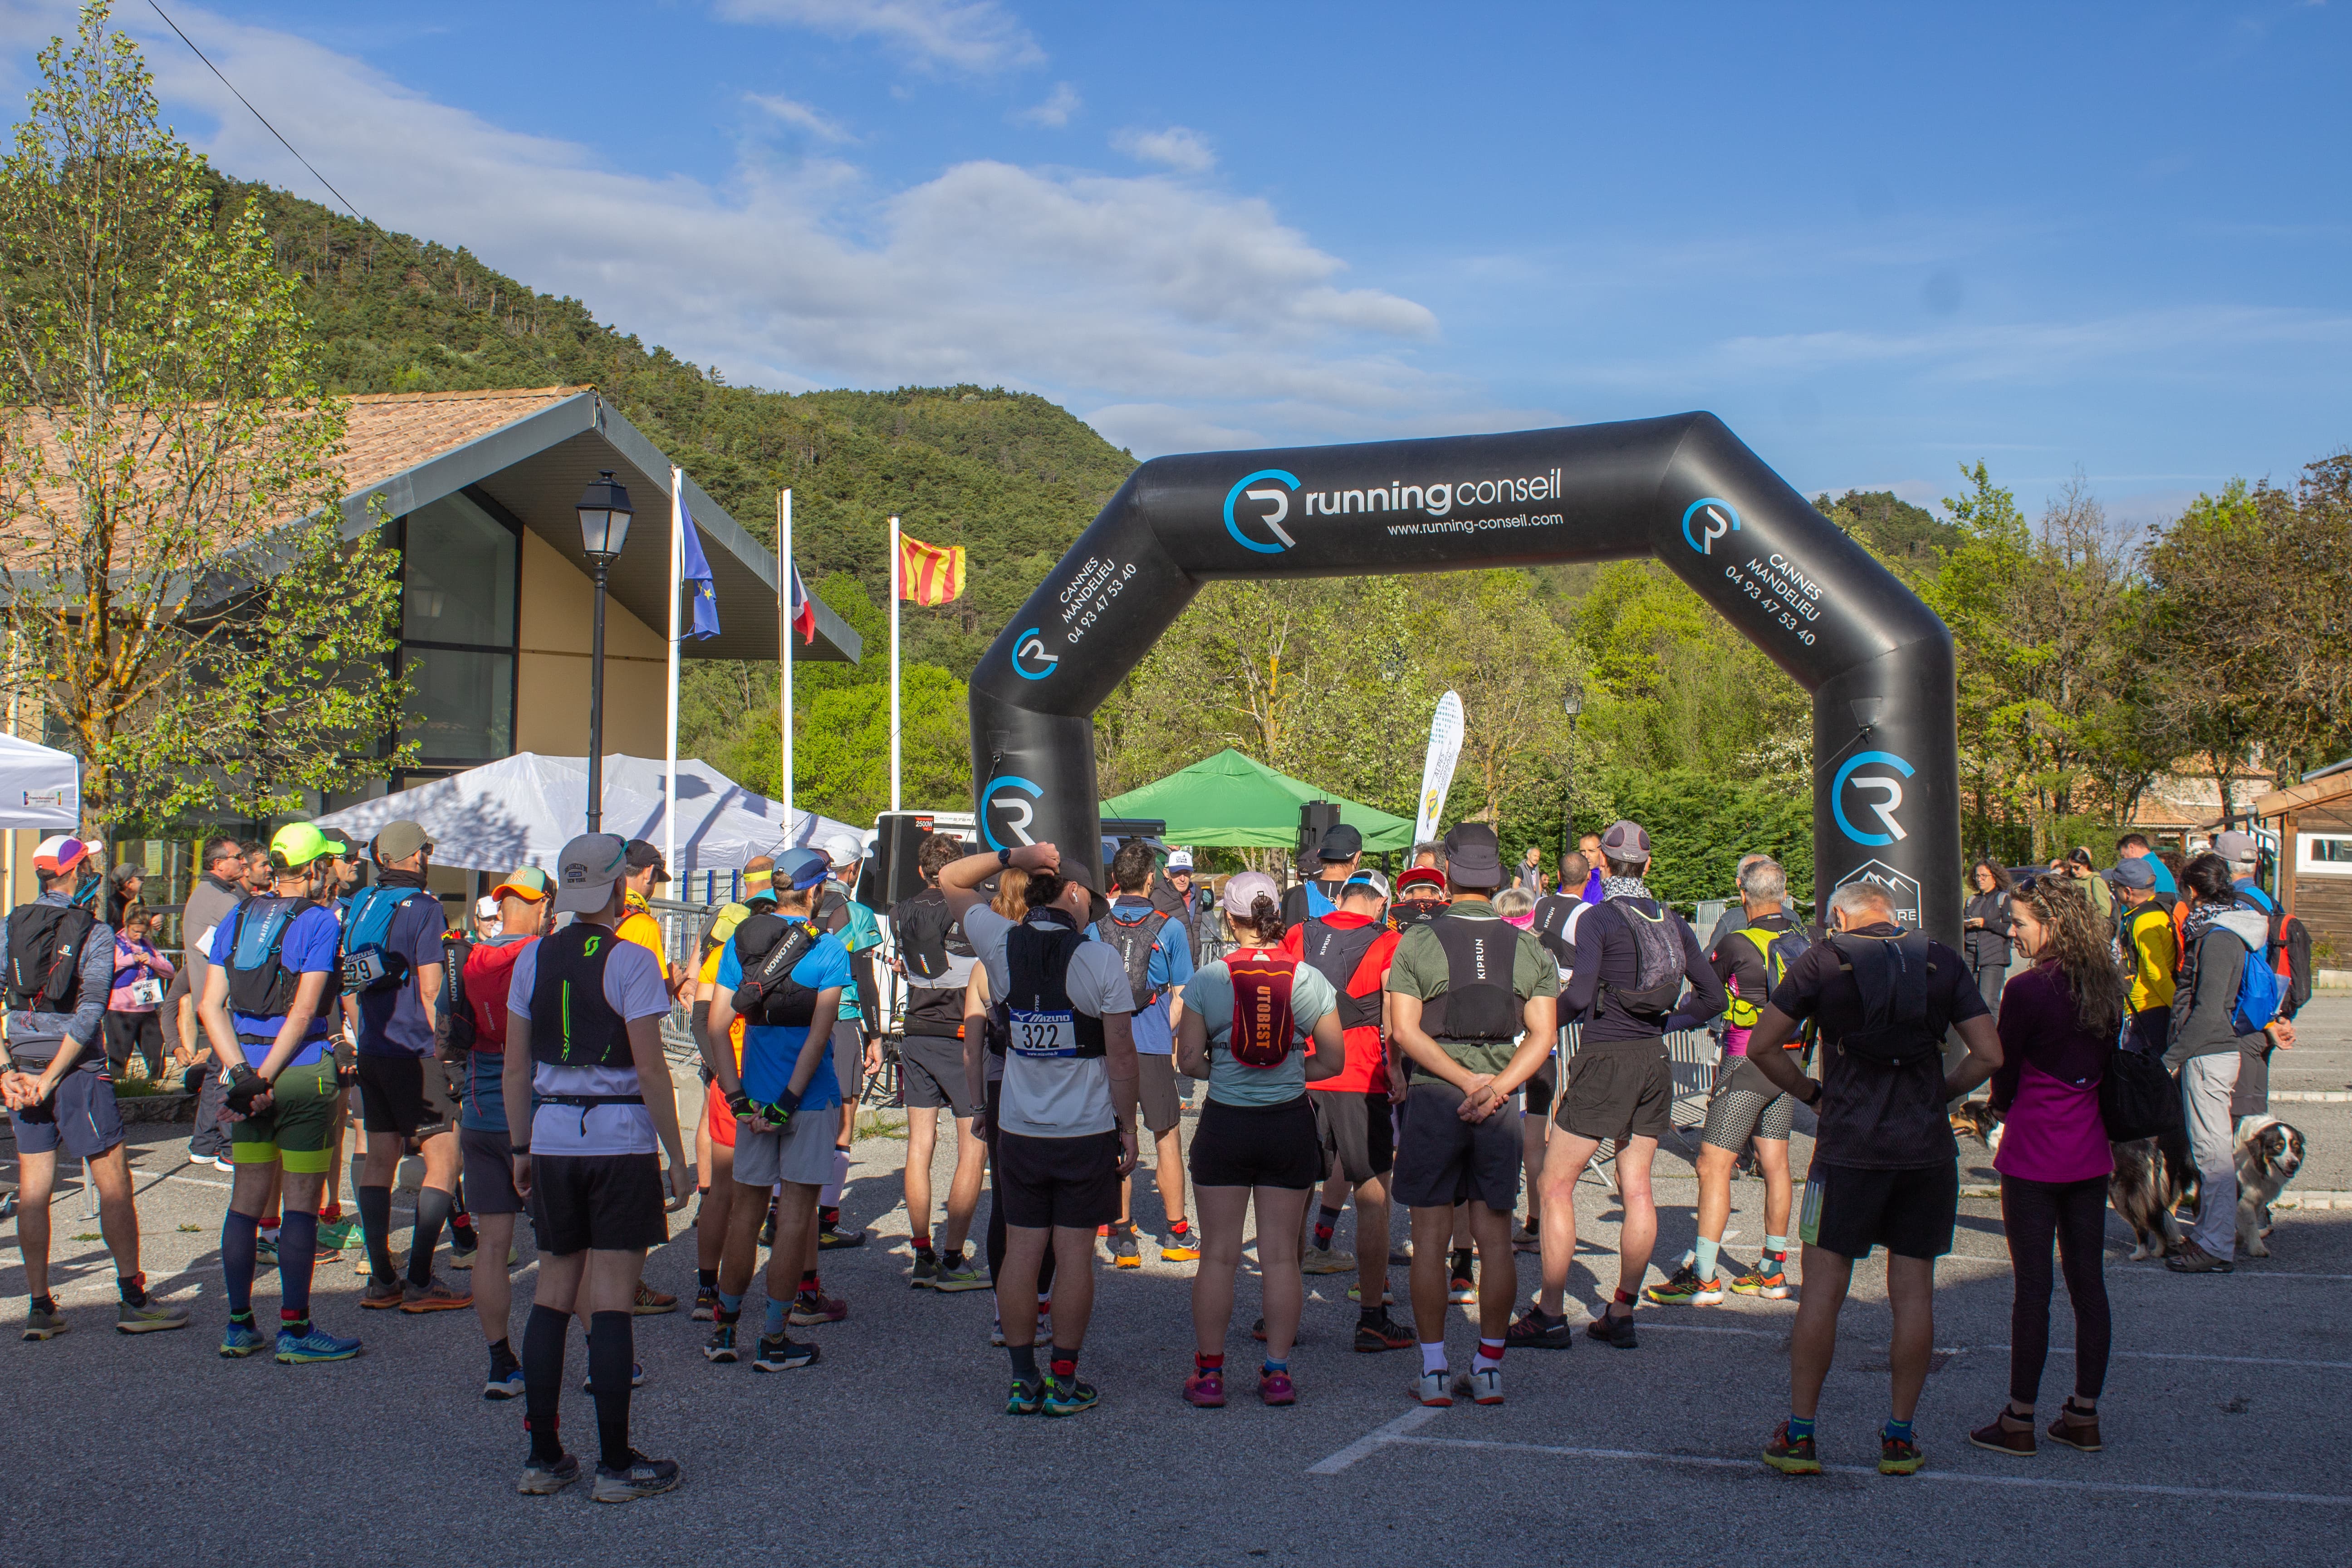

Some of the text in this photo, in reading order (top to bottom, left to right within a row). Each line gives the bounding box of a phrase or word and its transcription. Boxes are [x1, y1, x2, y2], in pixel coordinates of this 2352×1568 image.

[1387, 512, 1563, 535] www.running-conseil.com
[1060, 557, 1098, 603] CANNES
[1062, 559, 1115, 623] MANDELIEU
[1746, 558, 1820, 622] MANDELIEU
[1769, 554, 1823, 600] CANNES
[1068, 564, 1137, 644] 04 93 47 53 40
[1725, 566, 1816, 646] 04 93 47 53 40
[1434, 752, 1445, 779] ALPES
[259, 904, 277, 943] RAIDLIGHT
[1544, 907, 1555, 928] KIPRUN
[764, 931, 799, 975] SALOMON
[1320, 934, 1332, 955] KIPRUN
[1475, 939, 1486, 979] KIPRUN
[13, 958, 23, 986] SALOMON
[448, 949, 457, 1002] SALOMON
[143, 991, 153, 1002] 20
[1022, 1024, 1060, 1049] 322
[1257, 986, 1271, 1049] UTOBEST
[632, 1469, 657, 1480] HOKA
